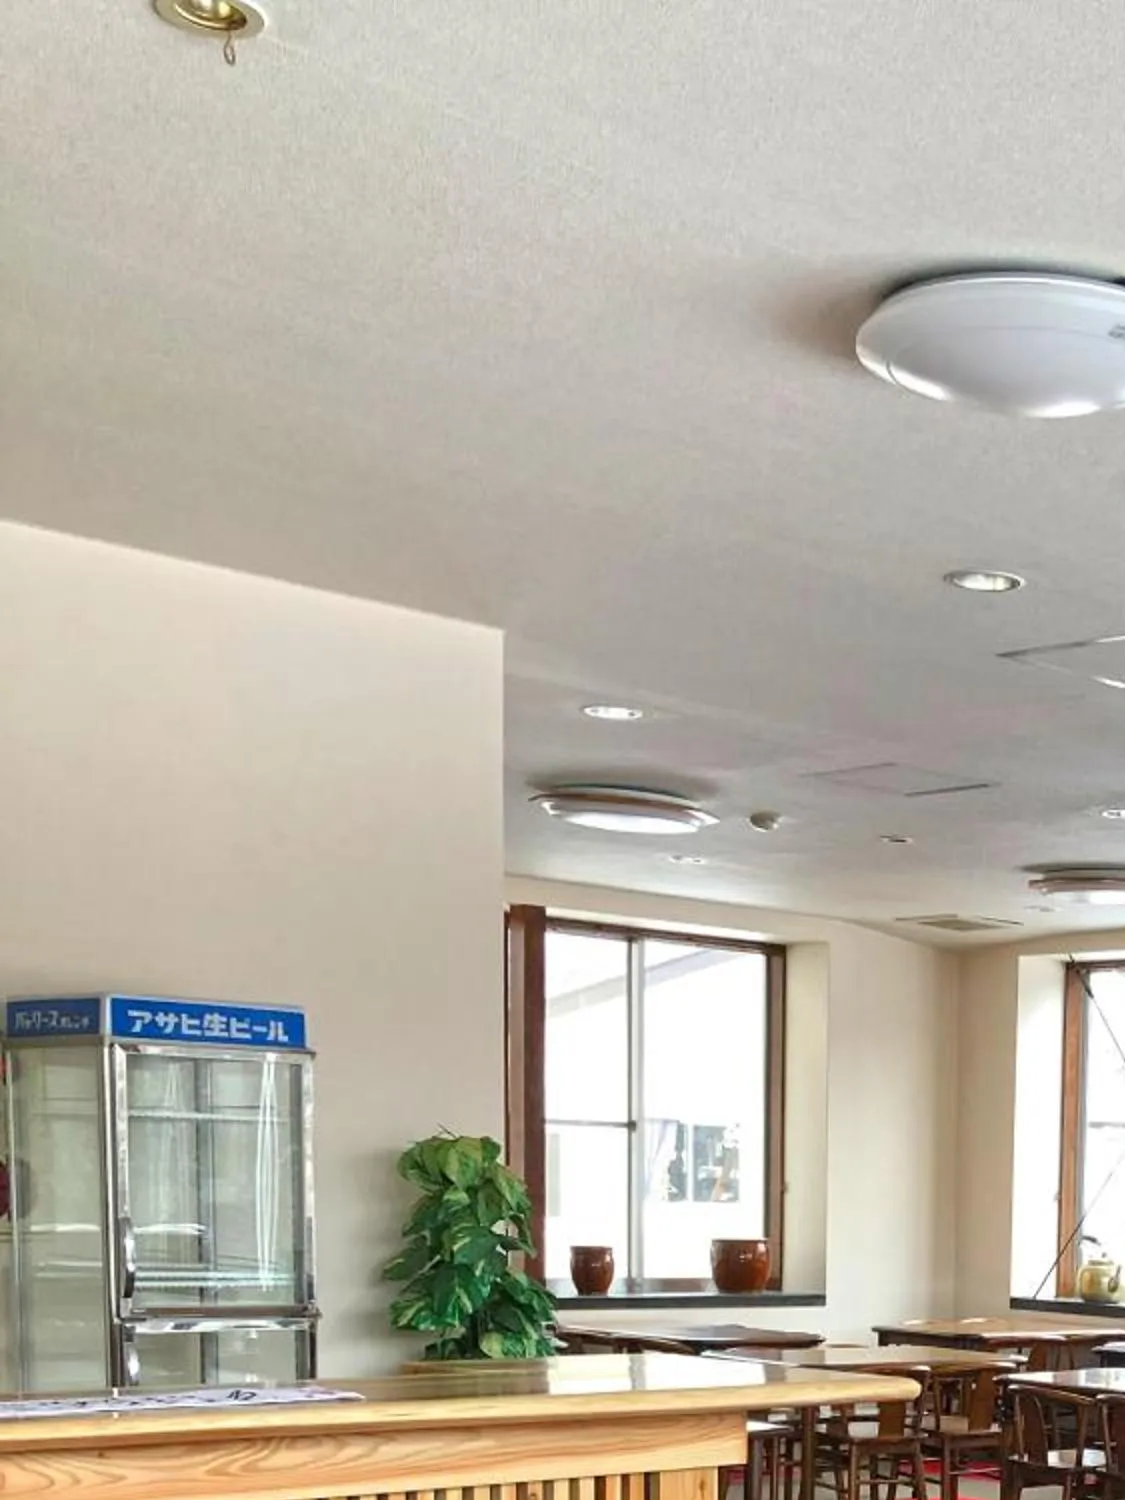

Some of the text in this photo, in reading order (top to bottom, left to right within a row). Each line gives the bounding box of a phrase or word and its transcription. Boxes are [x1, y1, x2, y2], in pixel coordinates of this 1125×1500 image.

[127, 1009, 289, 1042] アサヒ生ビール
